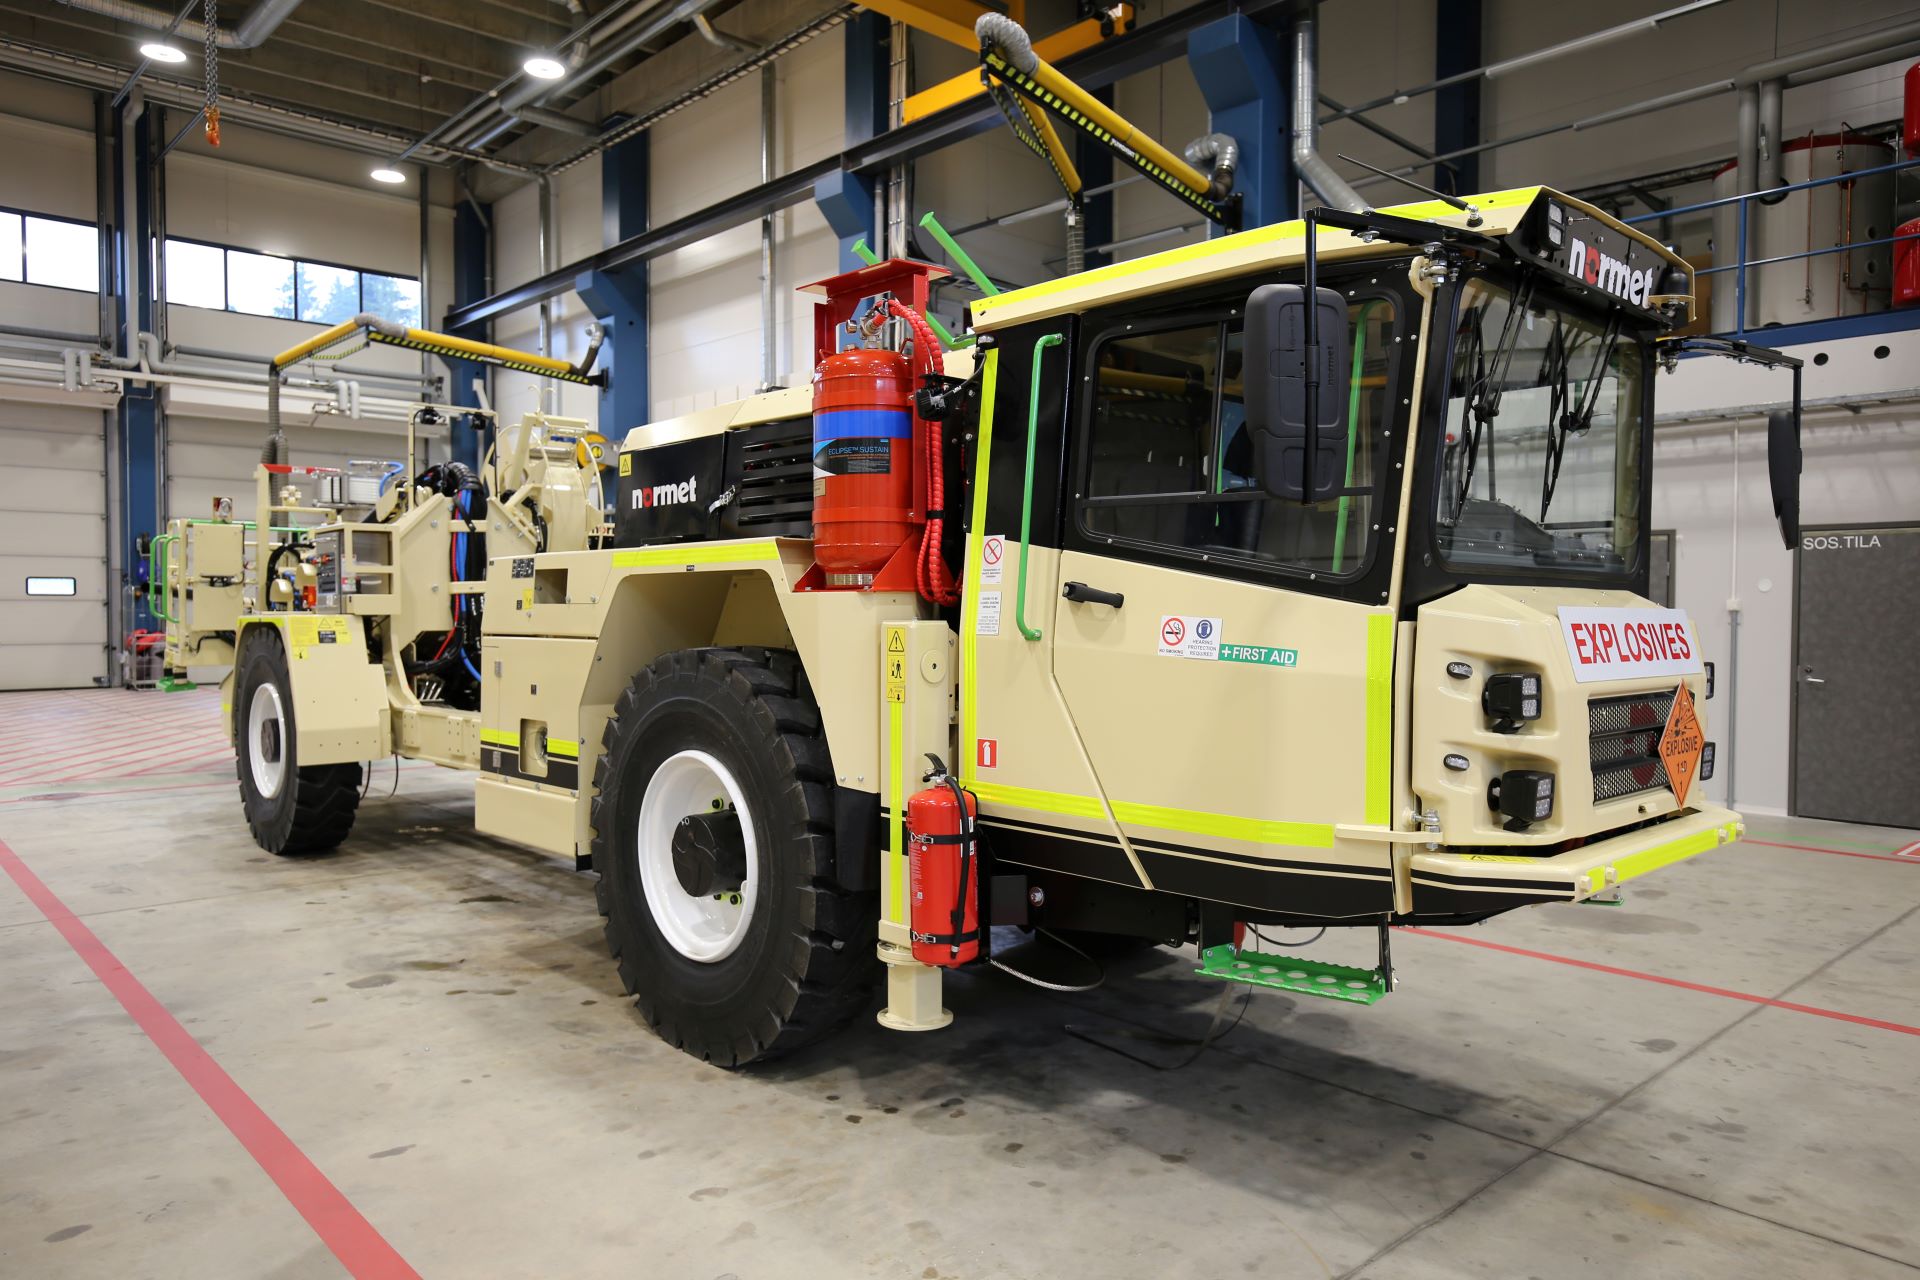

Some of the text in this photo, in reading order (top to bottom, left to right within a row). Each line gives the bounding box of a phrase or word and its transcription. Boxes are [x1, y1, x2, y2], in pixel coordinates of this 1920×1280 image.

[1568, 237, 1654, 309] normet
[860, 446, 889, 454] SUSTAIN
[632, 474, 697, 510] normet
[1803, 535, 1881, 550] SOS.TILA
[1187, 644, 1217, 652] PROTECTION
[1570, 622, 1691, 664] EXPLOSIVES
[1232, 646, 1295, 664] FIRST AID
[1665, 735, 1698, 757] EXPLOSIVE
